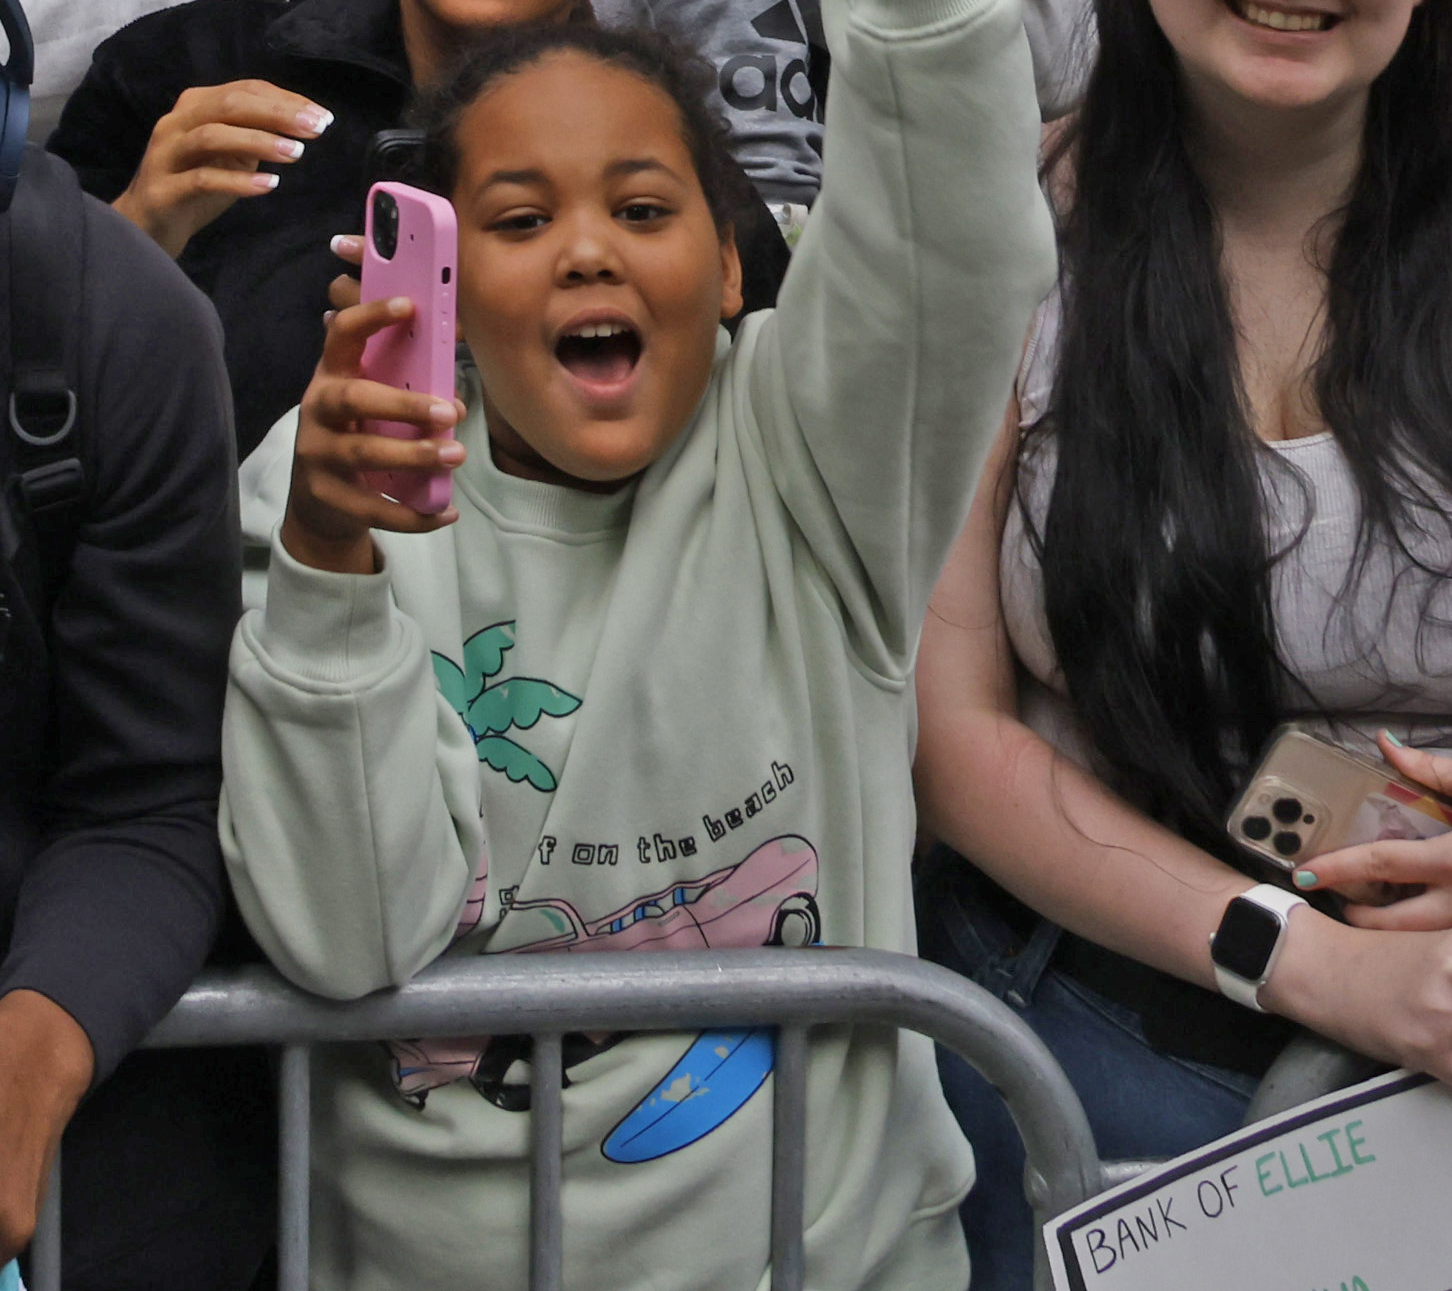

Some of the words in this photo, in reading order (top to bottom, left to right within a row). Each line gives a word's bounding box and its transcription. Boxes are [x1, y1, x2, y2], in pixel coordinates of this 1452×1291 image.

[571, 843, 619, 866] on
[637, 833, 698, 864] the
[702, 760, 795, 843] beach
[1084, 1197, 1189, 1275] BANK
[1197, 1166, 1238, 1218] OF
[1254, 1120, 1377, 1198] ELLIE
